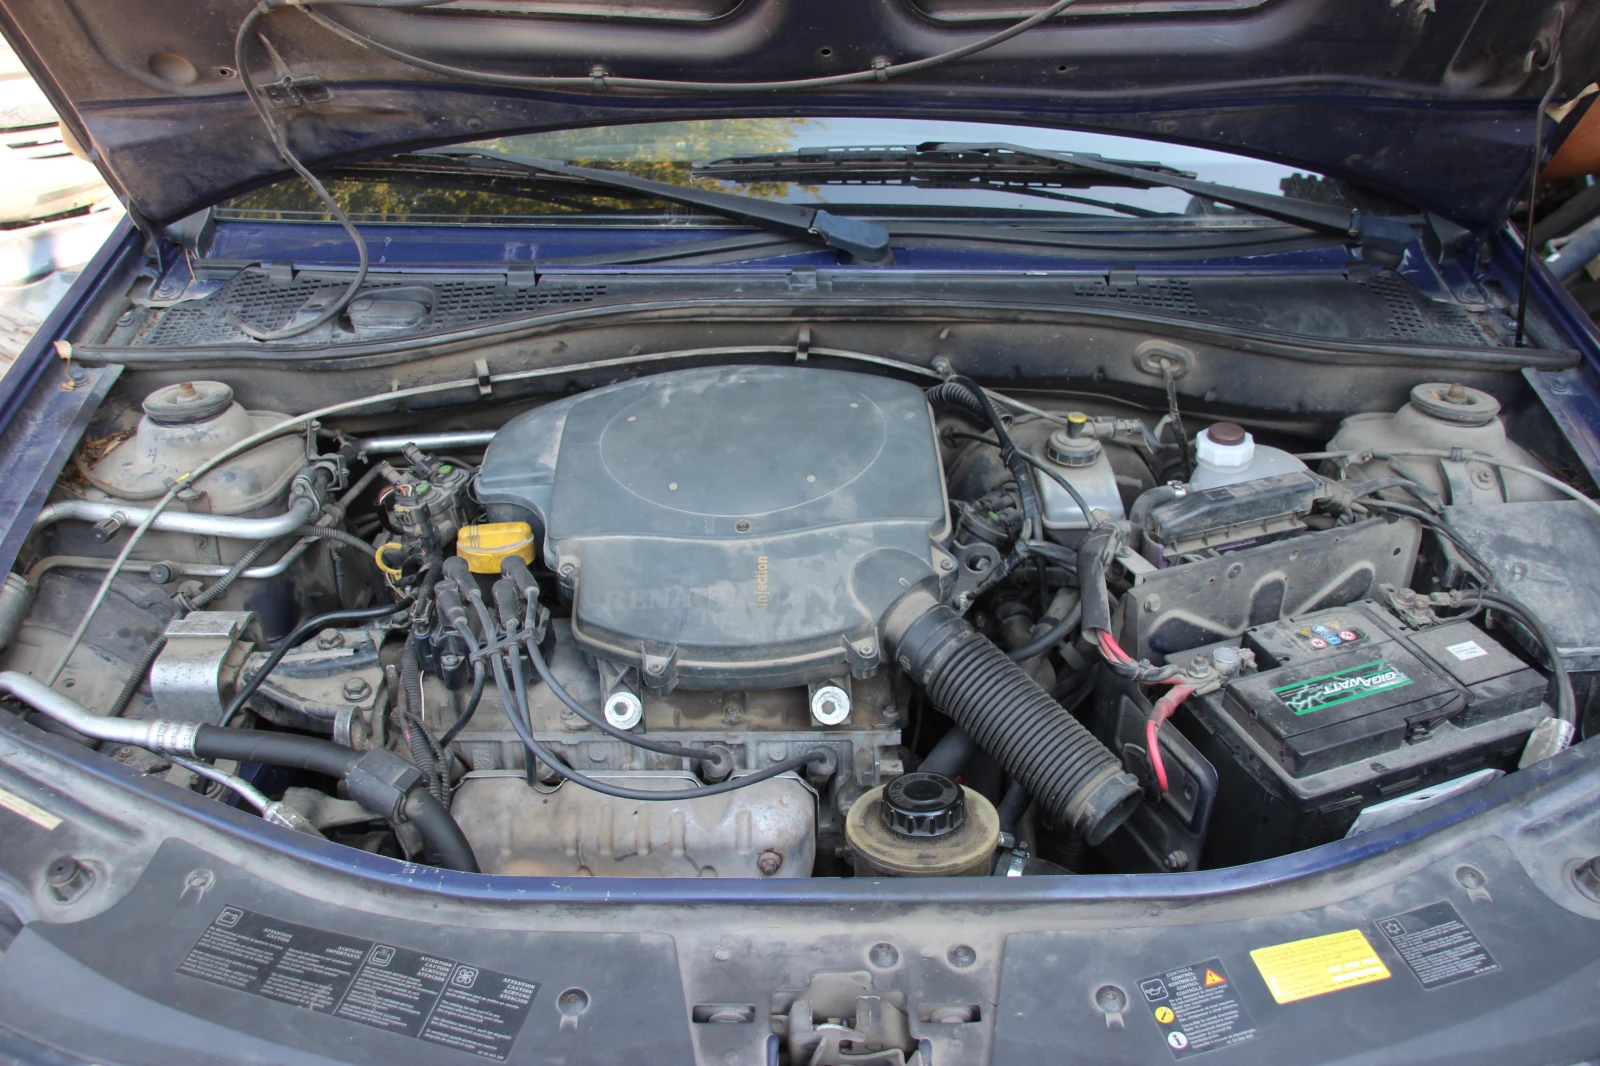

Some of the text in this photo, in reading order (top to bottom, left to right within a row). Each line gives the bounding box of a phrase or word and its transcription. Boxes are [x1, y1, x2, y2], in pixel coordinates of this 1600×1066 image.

[755, 555, 769, 608] injection
[1323, 671, 1396, 695] GIGAWATT
[263, 927, 293, 938] ATTENTION
[266, 933, 291, 943] CAUTION
[325, 947, 361, 960] IMPORTANTE
[337, 945, 364, 955] ACHTUNG
[420, 956, 452, 967] ATTENTION
[420, 967, 448, 977] ACHTUNG
[425, 963, 450, 972] CAUTION
[1171, 971, 1195, 981] CONTROL
[502, 978, 536, 989] ATTENTION
[1168, 976, 1197, 988] KONTROLLE
[1176, 981, 1200, 990] CONTROL
[503, 988, 531, 999] ACHTUNG
[507, 984, 534, 994] CAUTION
